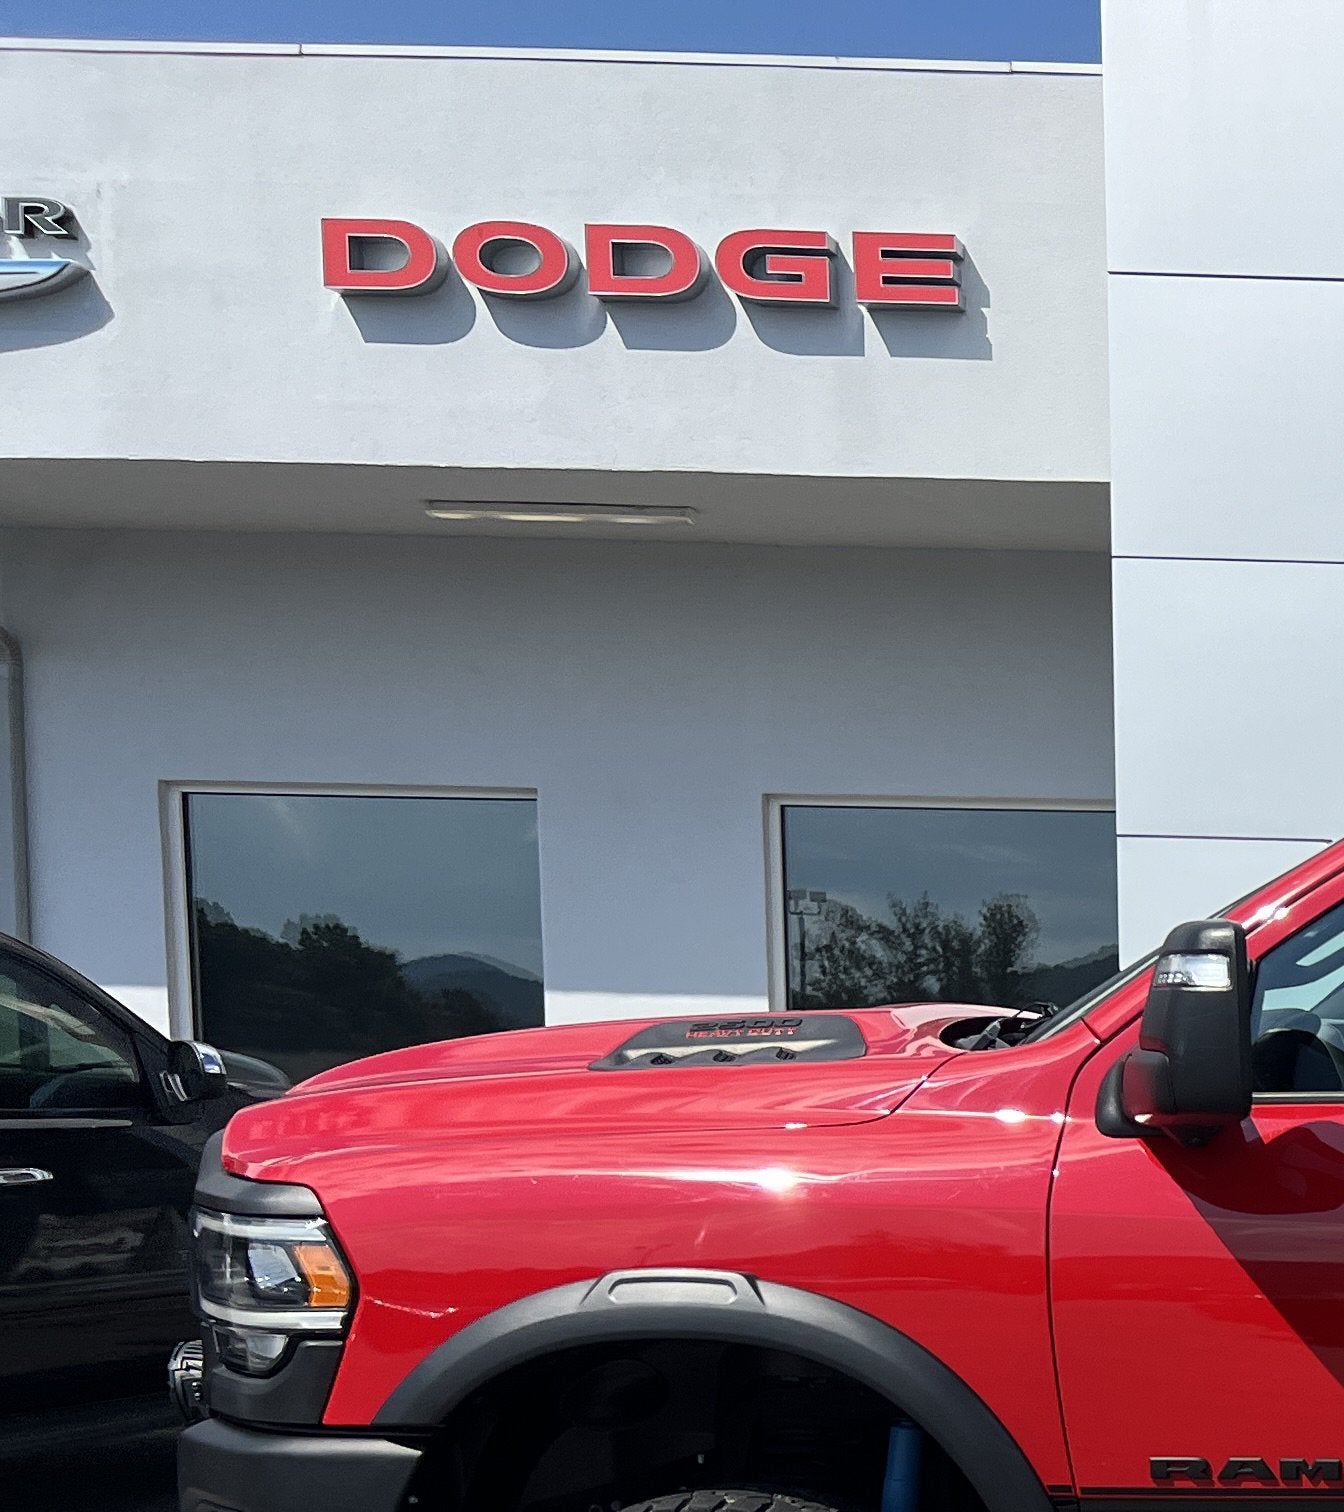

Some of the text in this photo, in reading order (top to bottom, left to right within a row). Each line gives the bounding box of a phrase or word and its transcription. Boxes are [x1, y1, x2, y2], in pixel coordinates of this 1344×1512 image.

[321, 218, 963, 307] DODGE
[685, 1027, 799, 1040] HEAVY DUTY
[689, 1019, 803, 1032] 2500
[1149, 1457, 1344, 1482] RAM
